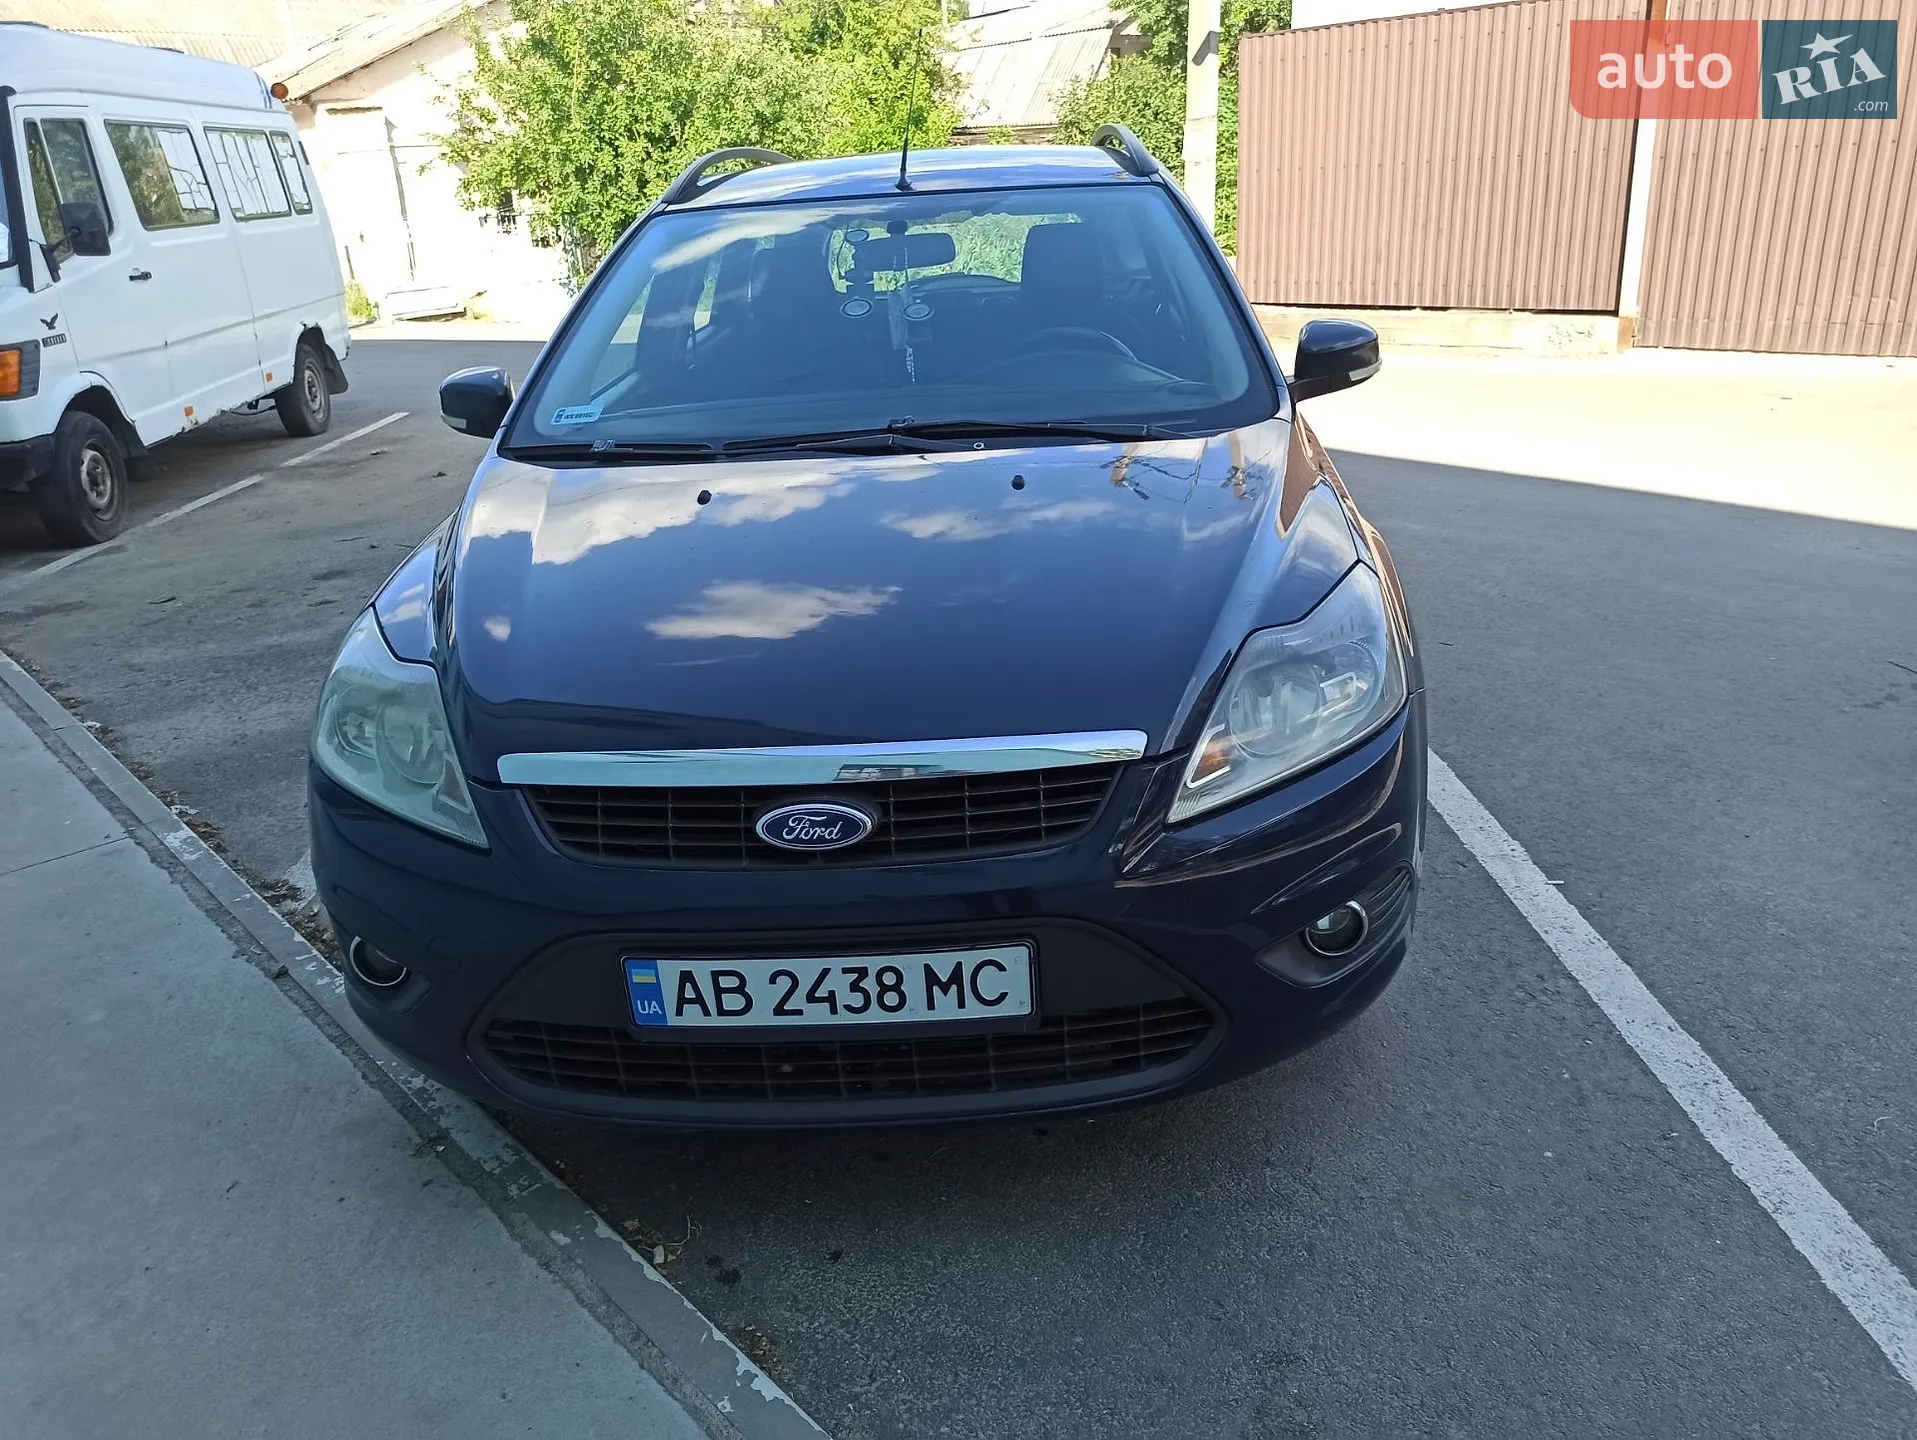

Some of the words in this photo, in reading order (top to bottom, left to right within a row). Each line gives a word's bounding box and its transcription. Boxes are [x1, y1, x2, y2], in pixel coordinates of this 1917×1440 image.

[782, 814, 844, 840] Ford
[674, 969, 754, 1018] AB
[767, 965, 907, 1017] 2438
[922, 957, 1010, 1011] MC
[636, 1000, 663, 1016] UA
